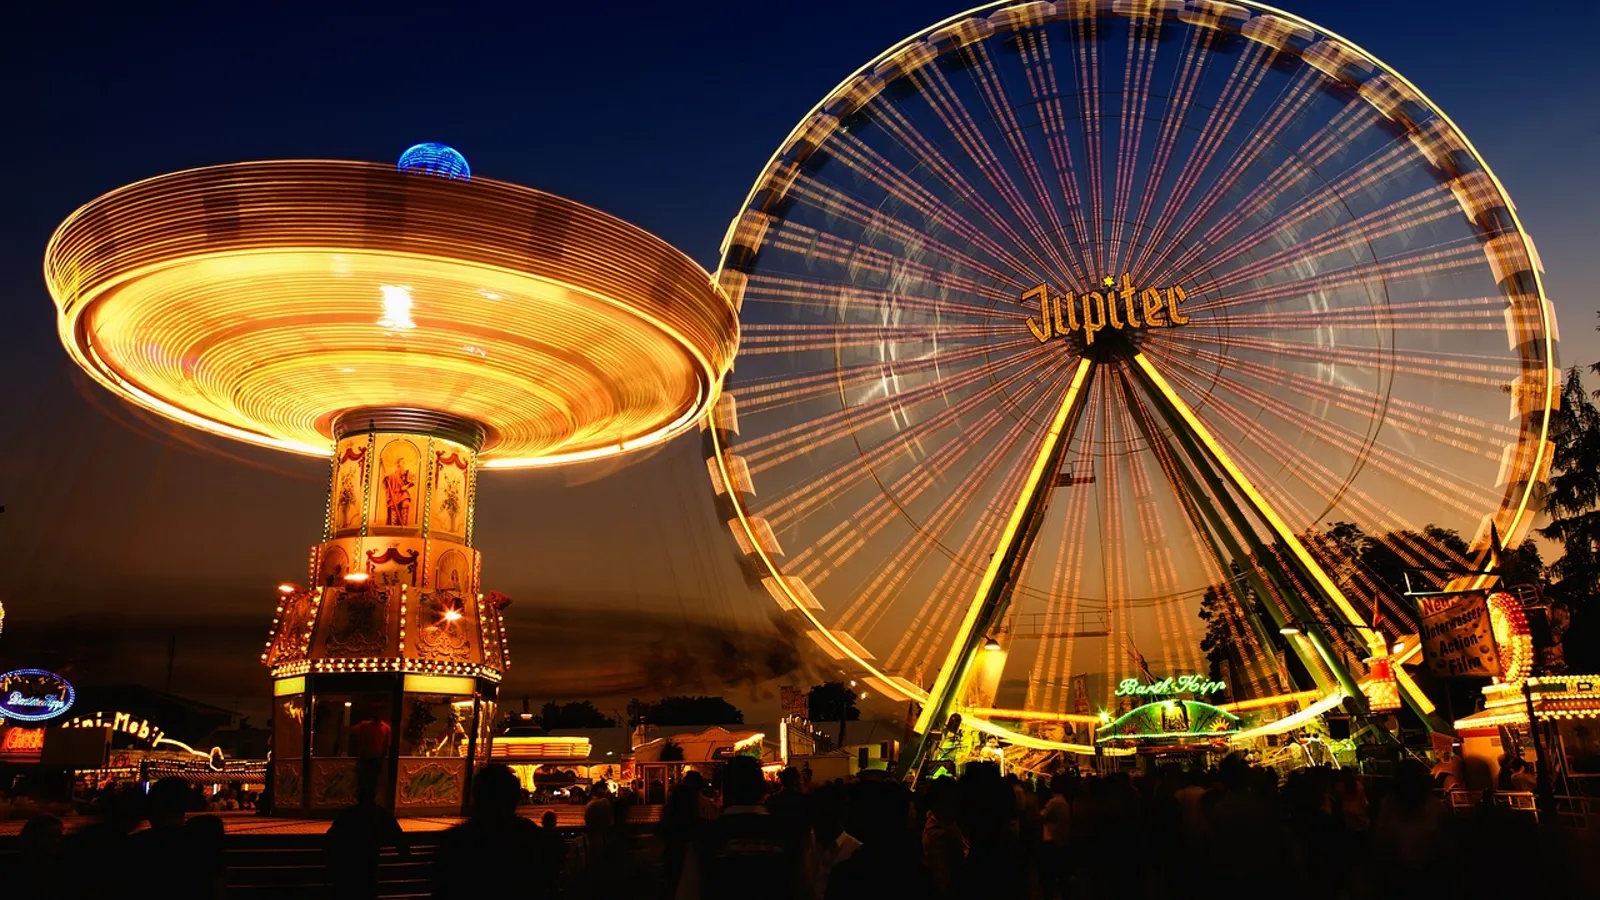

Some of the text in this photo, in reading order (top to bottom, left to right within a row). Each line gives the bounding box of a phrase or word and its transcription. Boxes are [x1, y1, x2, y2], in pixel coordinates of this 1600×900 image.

[1021, 271, 1190, 346] Jupiter
[1422, 606, 1486, 641] Unterwasser-
[1439, 633, 1484, 656] Action-
[1450, 656, 1481, 675] Film
[1115, 676, 1173, 696] Barth
